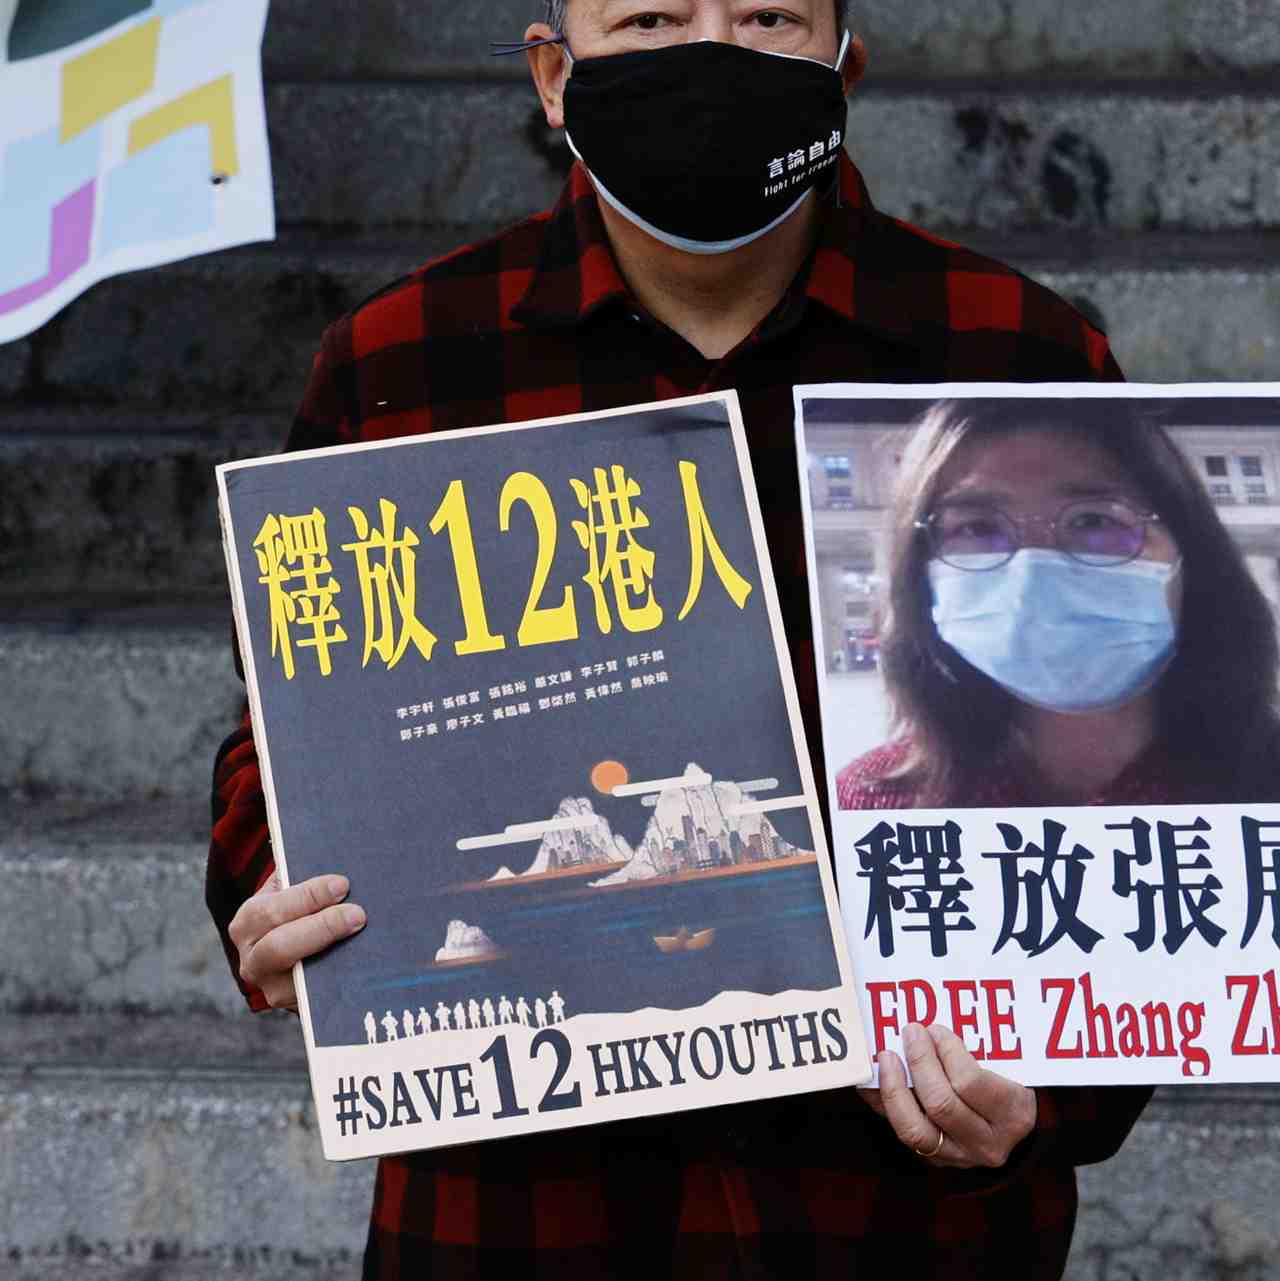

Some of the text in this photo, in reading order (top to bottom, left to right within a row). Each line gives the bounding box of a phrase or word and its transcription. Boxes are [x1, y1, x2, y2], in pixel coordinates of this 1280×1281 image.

[768, 130, 840, 178] 言論自由
[252, 460, 753, 681] 釋放12港人
[865, 979, 1022, 1062] FREE
[1040, 972, 1210, 1076] Zhang
